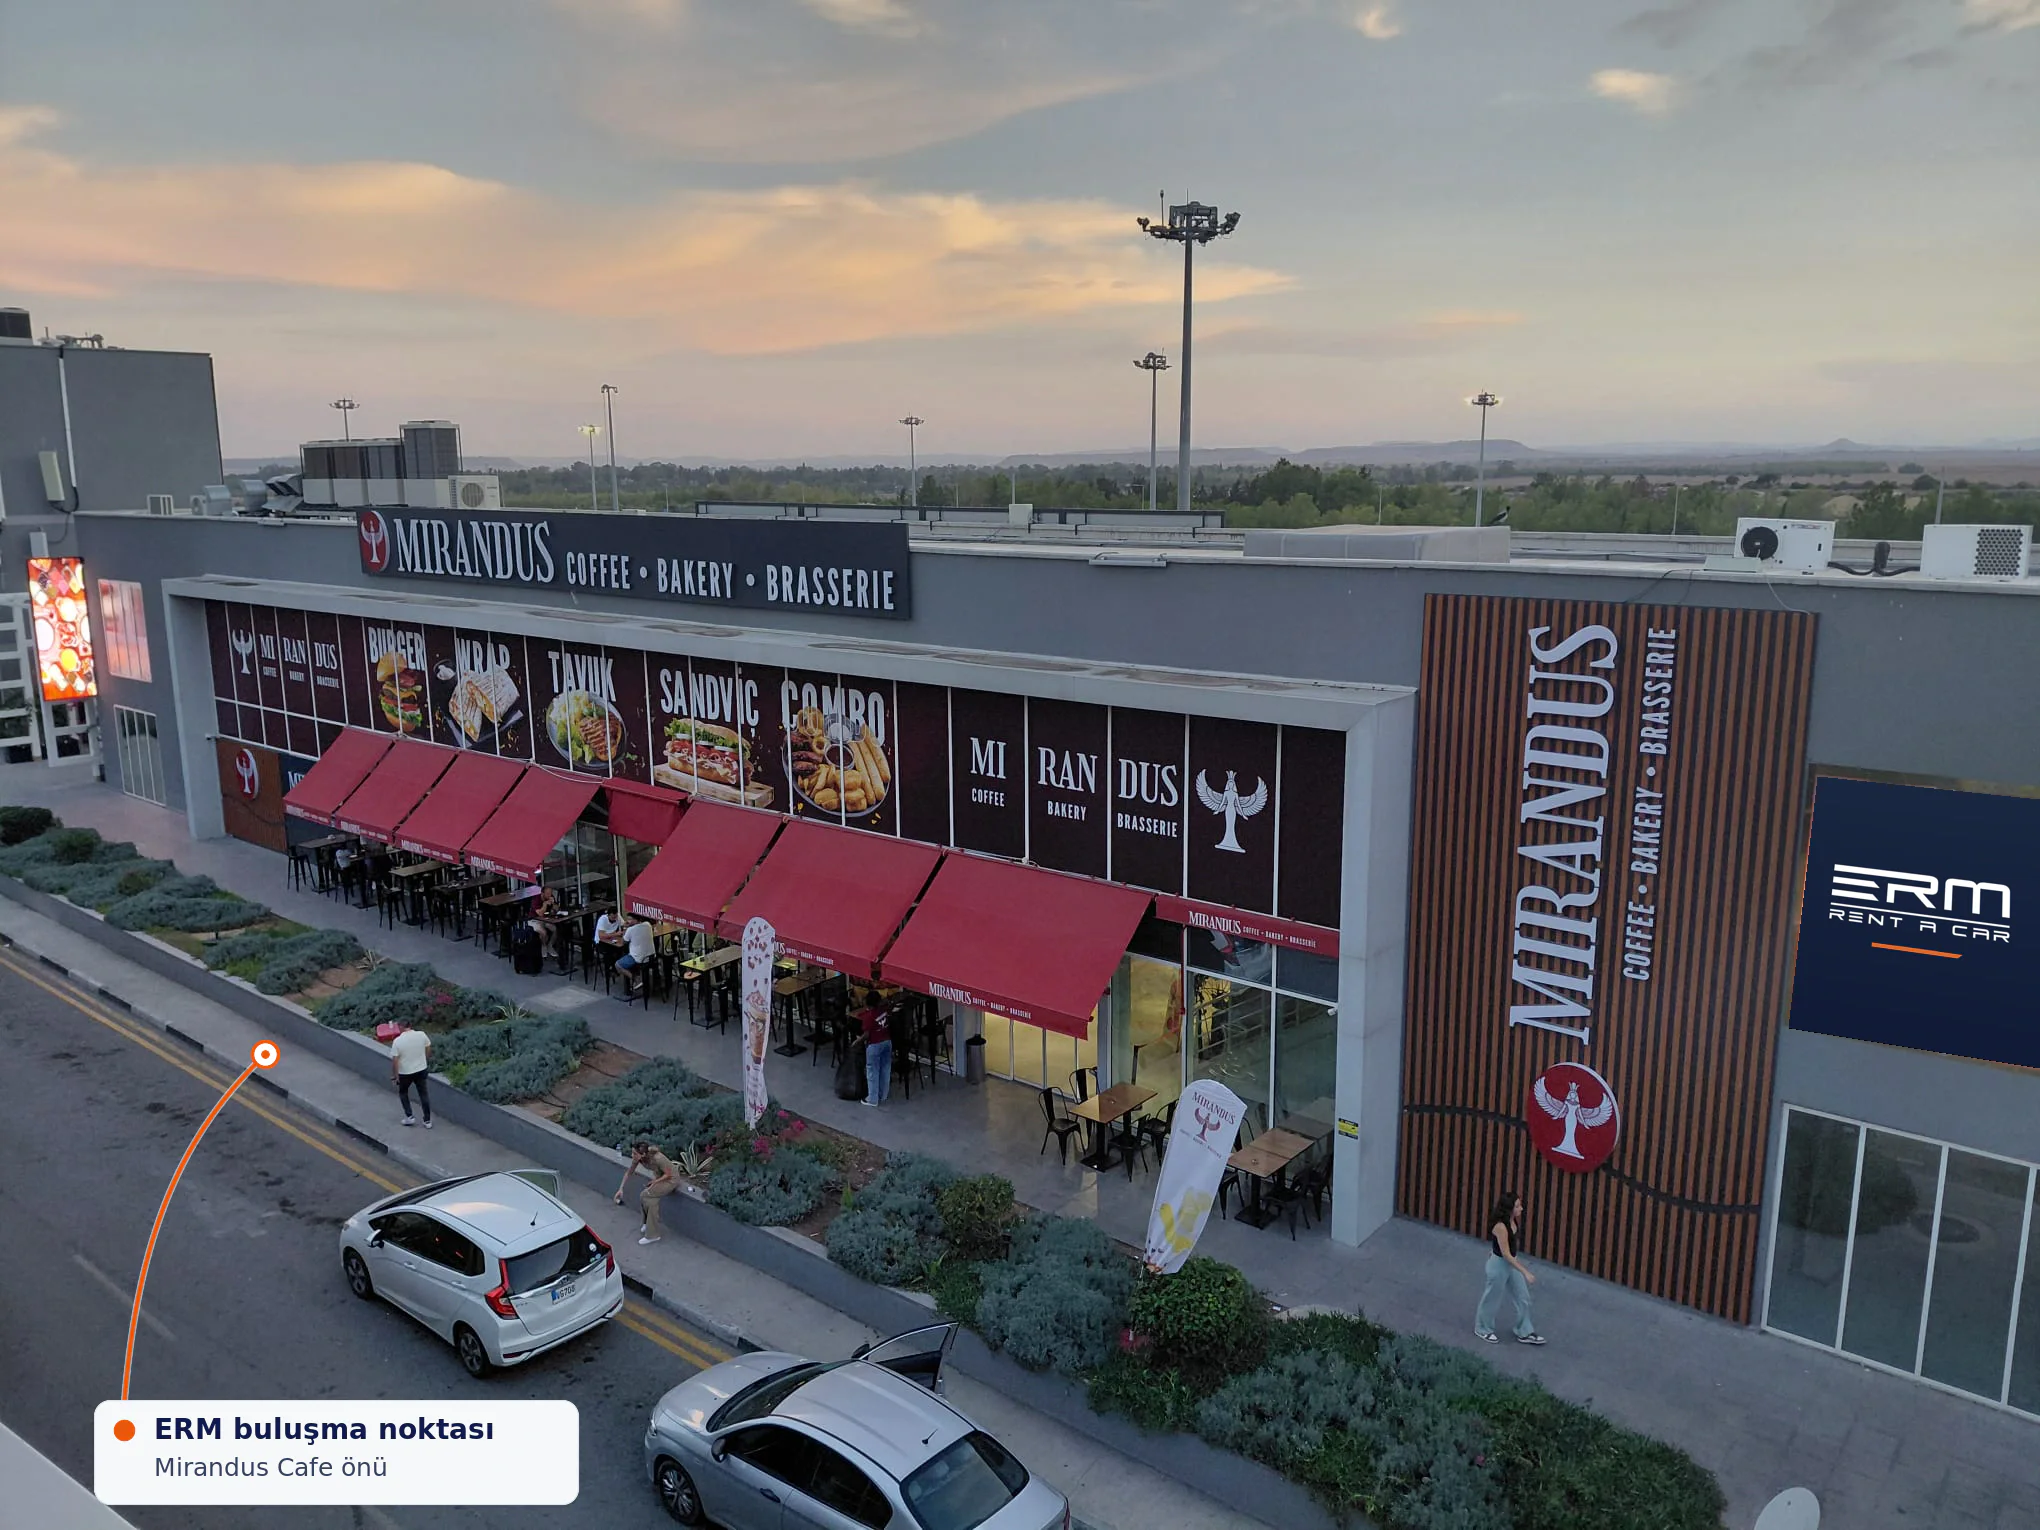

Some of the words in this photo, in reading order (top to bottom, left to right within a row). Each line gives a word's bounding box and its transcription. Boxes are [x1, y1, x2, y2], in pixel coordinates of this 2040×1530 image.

[393, 518, 555, 584] MIRANDUS
[566, 551, 631, 590] COFFEE
[657, 558, 733, 599] BAKERY
[766, 564, 894, 610] BRASSERIE
[260, 633, 276, 660] MI
[282, 637, 307, 665] RAN
[313, 642, 338, 670] DUS
[368, 626, 426, 672] BURGER
[456, 637, 511, 674] WRAP
[547, 650, 617, 702] TAVUK
[660, 667, 759, 738] SANDVİÇ
[1639, 627, 1677, 755] BRASSERIE
[781, 680, 885, 747] COMBO
[970, 737, 1007, 779] MI
[1037, 746, 1098, 794] RAN
[1118, 758, 1179, 807] DUS
[971, 788, 1005, 807] COFFEE
[1047, 800, 1087, 821] BAKERY
[1117, 812, 1178, 838] BRASSERIE
[1509, 624, 1618, 1046] MIRANDUS
[1630, 786, 1664, 875] BAKERY
[1831, 864, 2011, 918] ERM
[1188, 911, 1242, 934] MIRANDUS
[1623, 900, 1656, 982] COFFEE
[1829, 908, 1903, 928] RENT
[1919, 920, 1937, 933] A
[1952, 925, 2011, 943] CAR
[928, 981, 972, 1005] MIRANDUS
[1193, 1091, 1236, 1125] MIRANDUS
